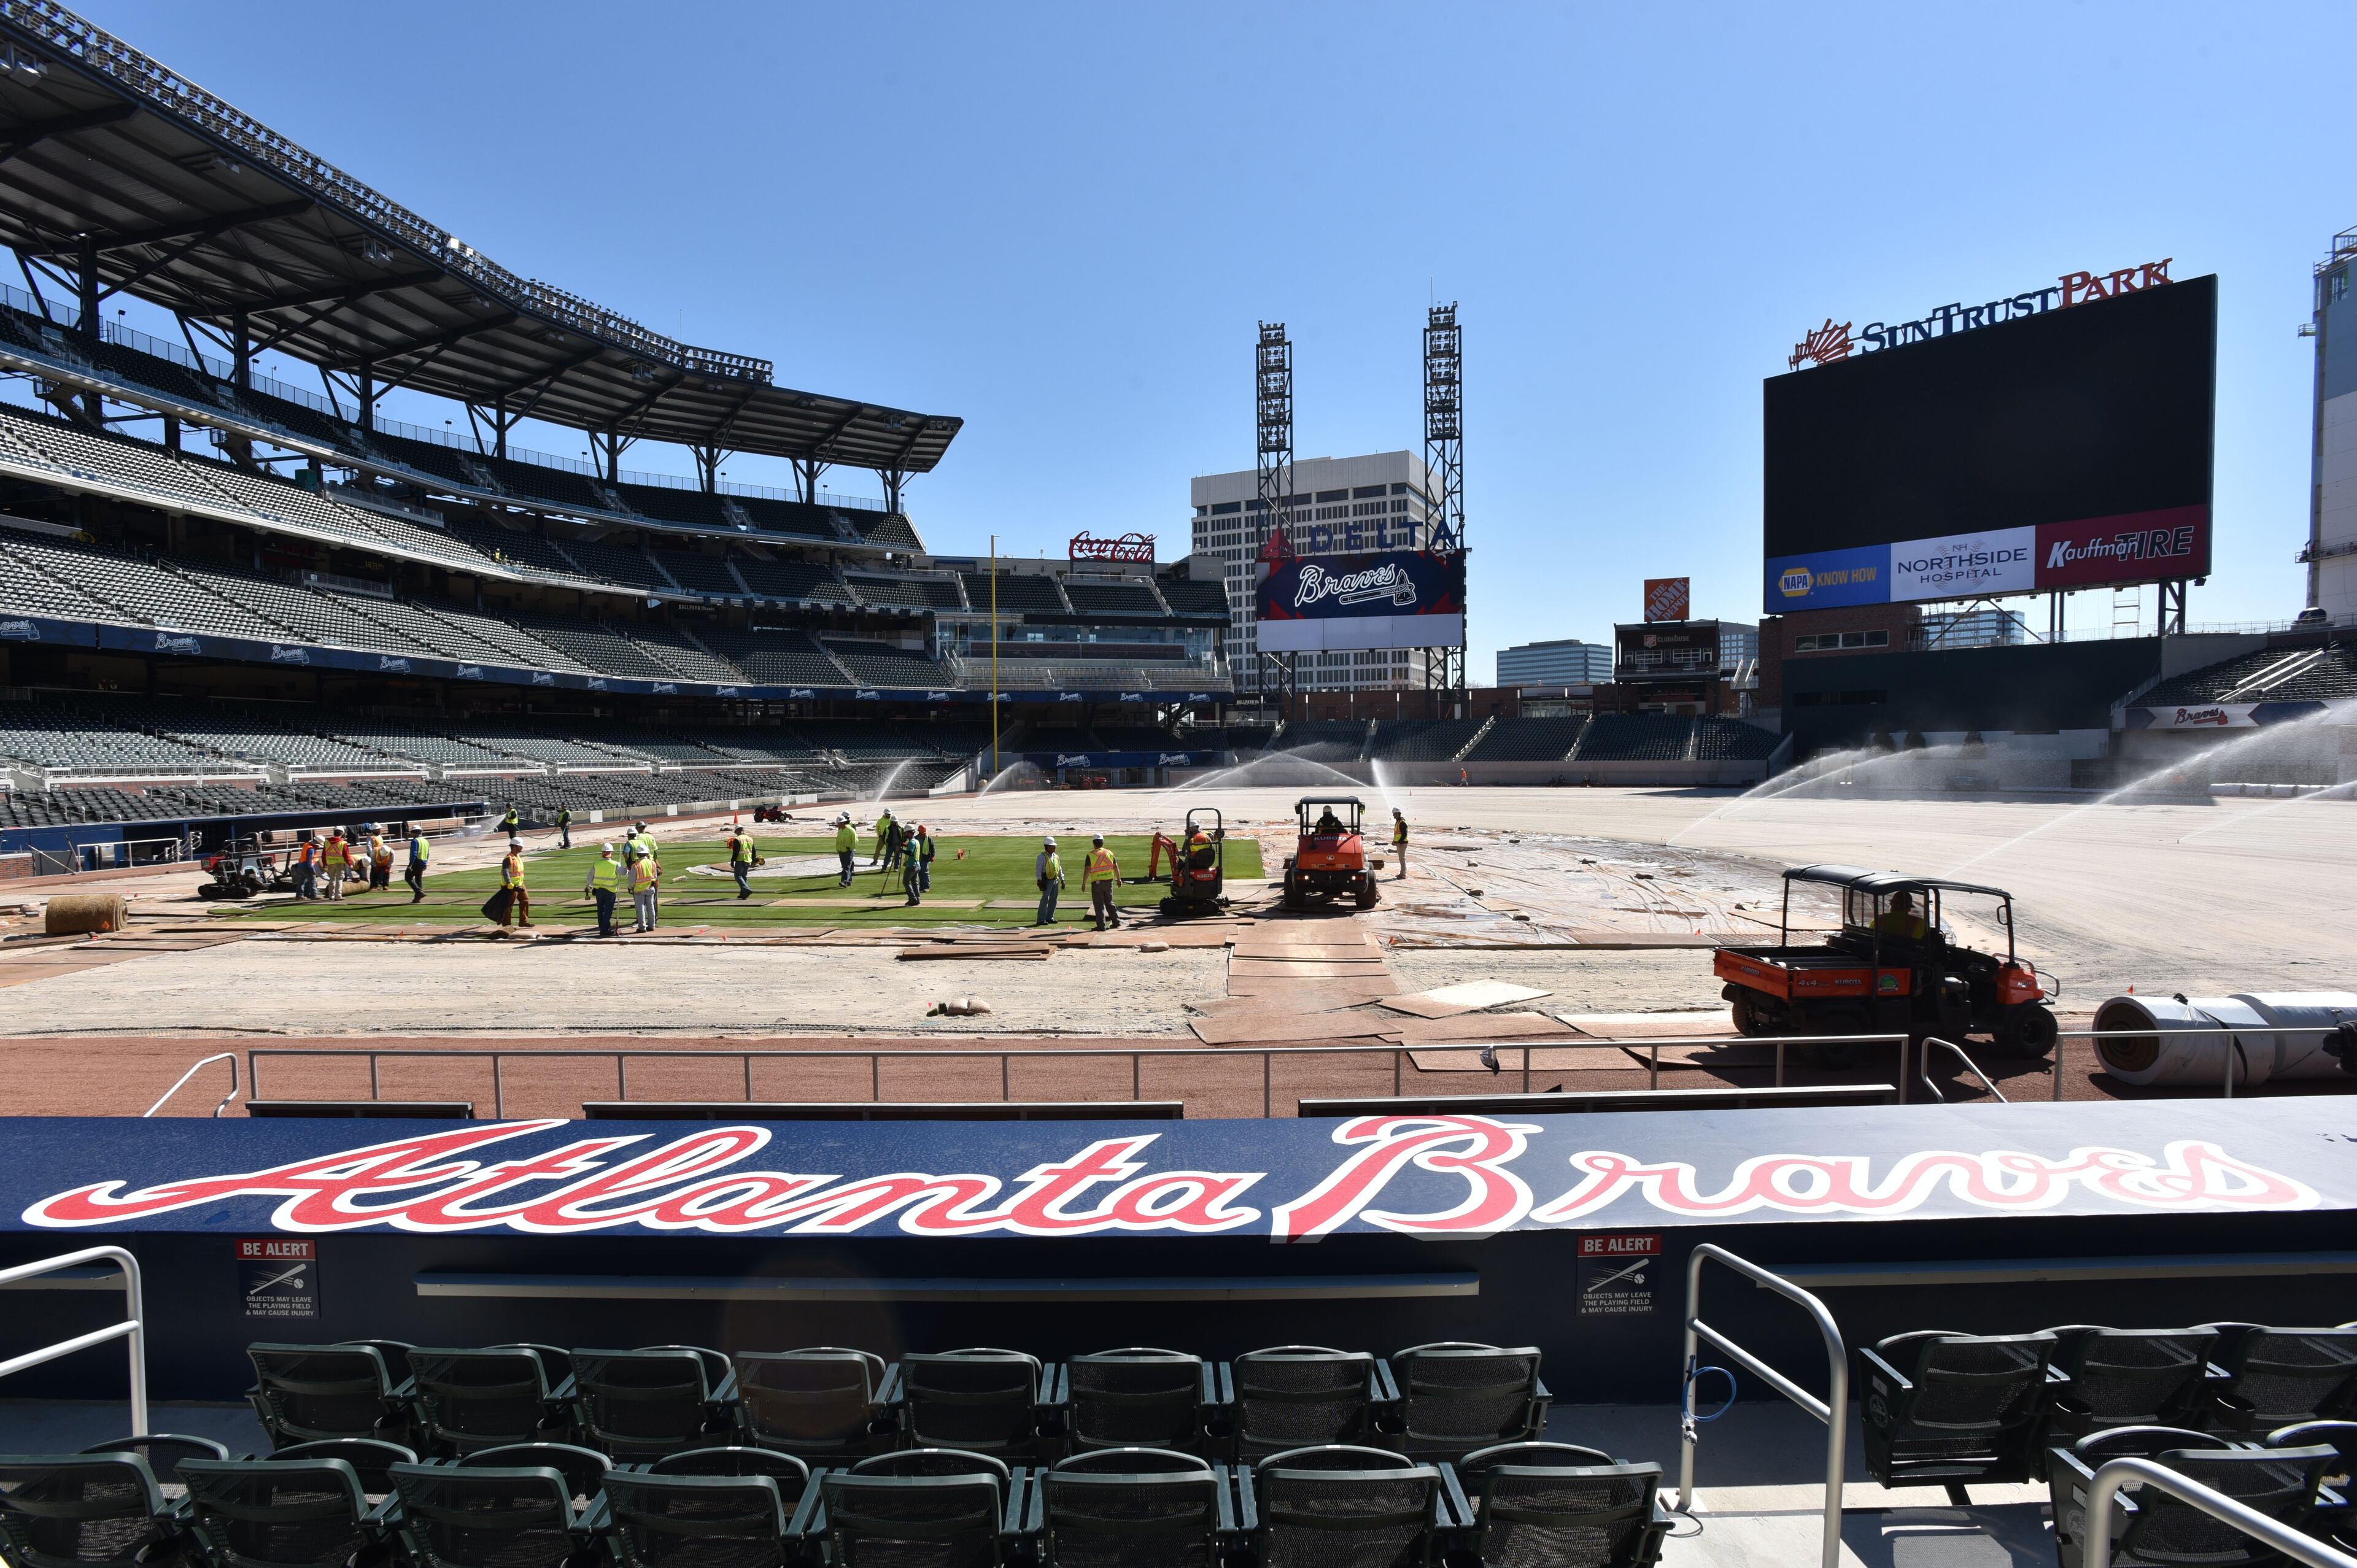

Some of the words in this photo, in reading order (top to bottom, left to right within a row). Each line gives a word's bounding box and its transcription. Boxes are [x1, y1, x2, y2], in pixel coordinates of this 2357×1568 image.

[2058, 257, 2174, 311] PARK
[1310, 518, 1457, 552] DELTA
[2046, 538, 2139, 569] Kauffman
[2115, 525, 2194, 562] TIRE
[1897, 547, 2027, 574] NORTHSIDE
[1295, 563, 1396, 608] Braves
[1783, 574, 1809, 590] NAPA
[1816, 570, 1849, 587] KNOW
[1851, 566, 1877, 582] HOW
[1920, 568, 2002, 584] HOSPITAL
[1645, 578, 1689, 621] HOME
[1649, 583, 1667, 600] THE
[1662, 592, 1689, 620] DEPOT
[155, 633, 193, 649] Braves
[2174, 708, 2219, 725] Braves
[1741, 965, 1759, 976] KUBOTA
[21, 1118, 1267, 1236] Atlanta
[1271, 1115, 2321, 1243] Braves
[243, 1242, 261, 1256] BE
[266, 1243, 308, 1256] ALERT
[1584, 1239, 1603, 1253] BE
[1608, 1237, 1654, 1252] ALERT
